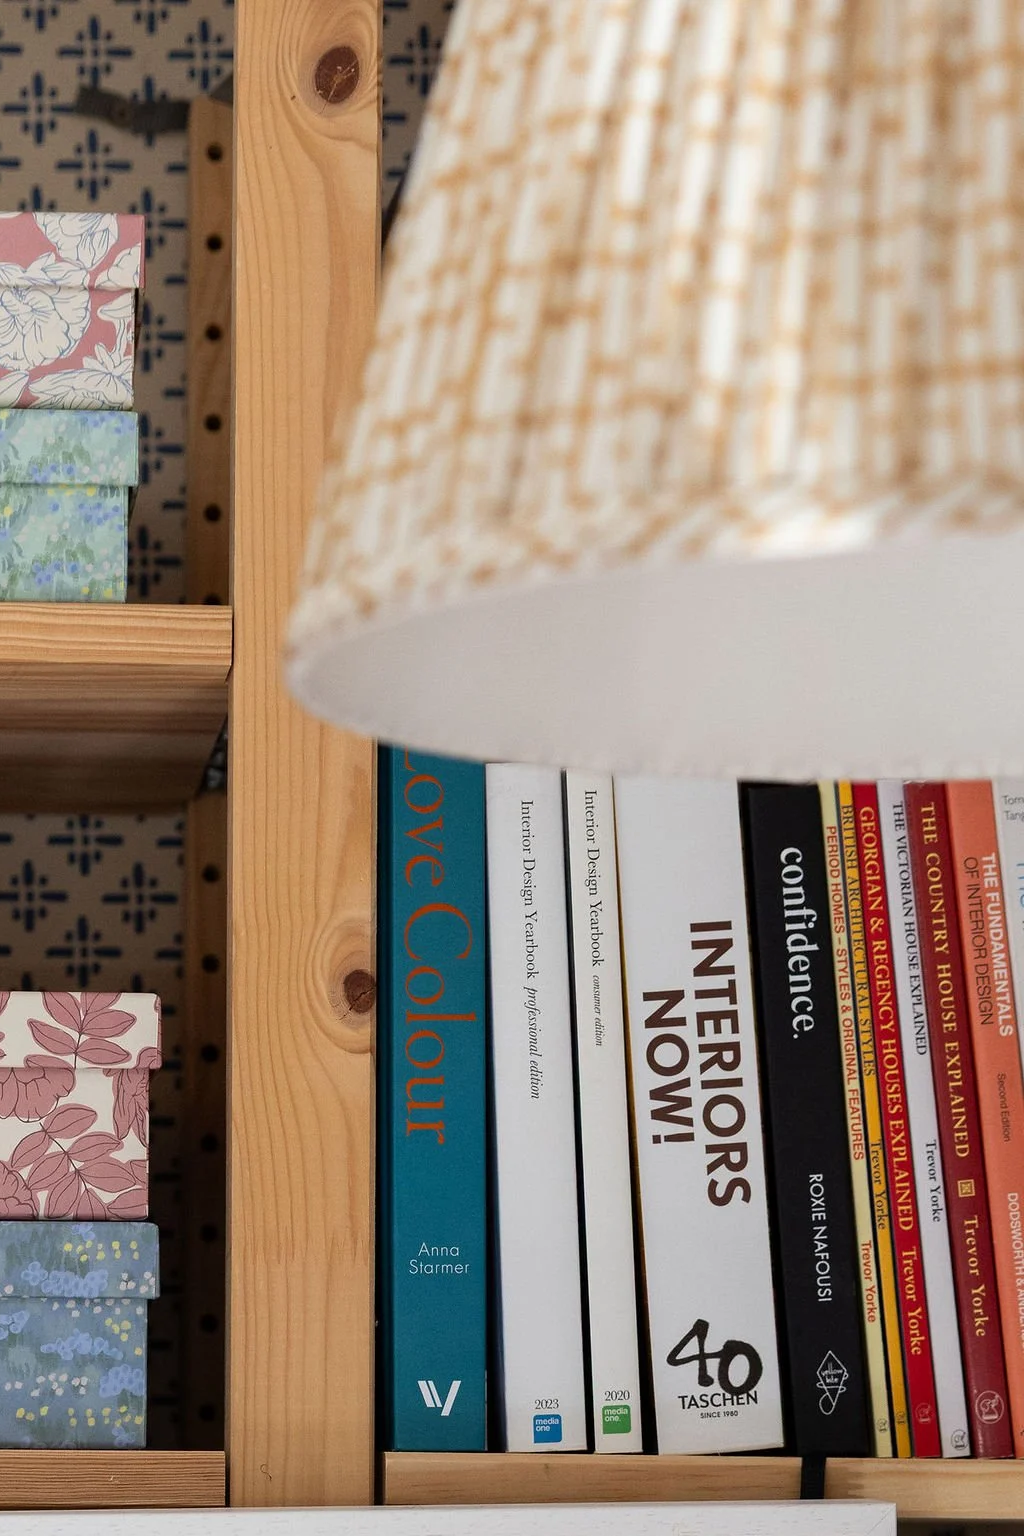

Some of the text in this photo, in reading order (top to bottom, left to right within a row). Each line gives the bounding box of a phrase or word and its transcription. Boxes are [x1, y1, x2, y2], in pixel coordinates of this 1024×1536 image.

[826, 825, 841, 879] PERIOD
[585, 790, 606, 1047] Interior Design Yearbook consumer edition
[780, 847, 819, 1039] confidence.
[831, 883, 846, 934] HOMES
[964, 857, 994, 1025] OF INTERIOR DESIGN
[520, 800, 544, 1099] Interior Design Yearbook professional edition
[836, 948, 851, 1001] STYLES
[981, 852, 1013, 1037] THE FUNDAMENTALS
[404, 903, 476, 1145] Colour
[841, 1005, 852, 1014] &
[841, 805, 888, 1230] BRITISH ARCHITECTURAL STYLES Trevor Yorke
[893, 800, 943, 1222] THE VICTORIAN HOUSE EXPLAINED Trevor Yorke
[643, 989, 695, 1144] NOW!
[690, 920, 751, 1207] INTERIORS
[842, 1018, 859, 1085] ORIGINAL
[860, 806, 926, 1355] GEORGIAN & REGENCY HOUSES EXPLAINED Trevor Yorke
[921, 802, 989, 1337] THE COUNTRY HOUSE EXPLAINED Trevor Yorke
[848, 1089, 864, 1160] FEATURES
[996, 1072, 1011, 1142] Second Edition
[409, 1259, 470, 1274] Starmer
[418, 1242, 460, 1257] Anna
[809, 1174, 832, 1302] ROXIE NAFOUSI
[861, 1240, 872, 1281] Trevor
[1008, 1193, 1024, 1276] DODSWORTH
[865, 1285, 877, 1322] Yorke
[535, 1399, 559, 1410] 2023
[535, 1417, 559, 1425] media
[604, 1390, 630, 1401] 2020
[604, 1407, 629, 1415] media
[678, 1390, 758, 1410] TASCHEN
[700, 1411, 721, 1419] SINCE
